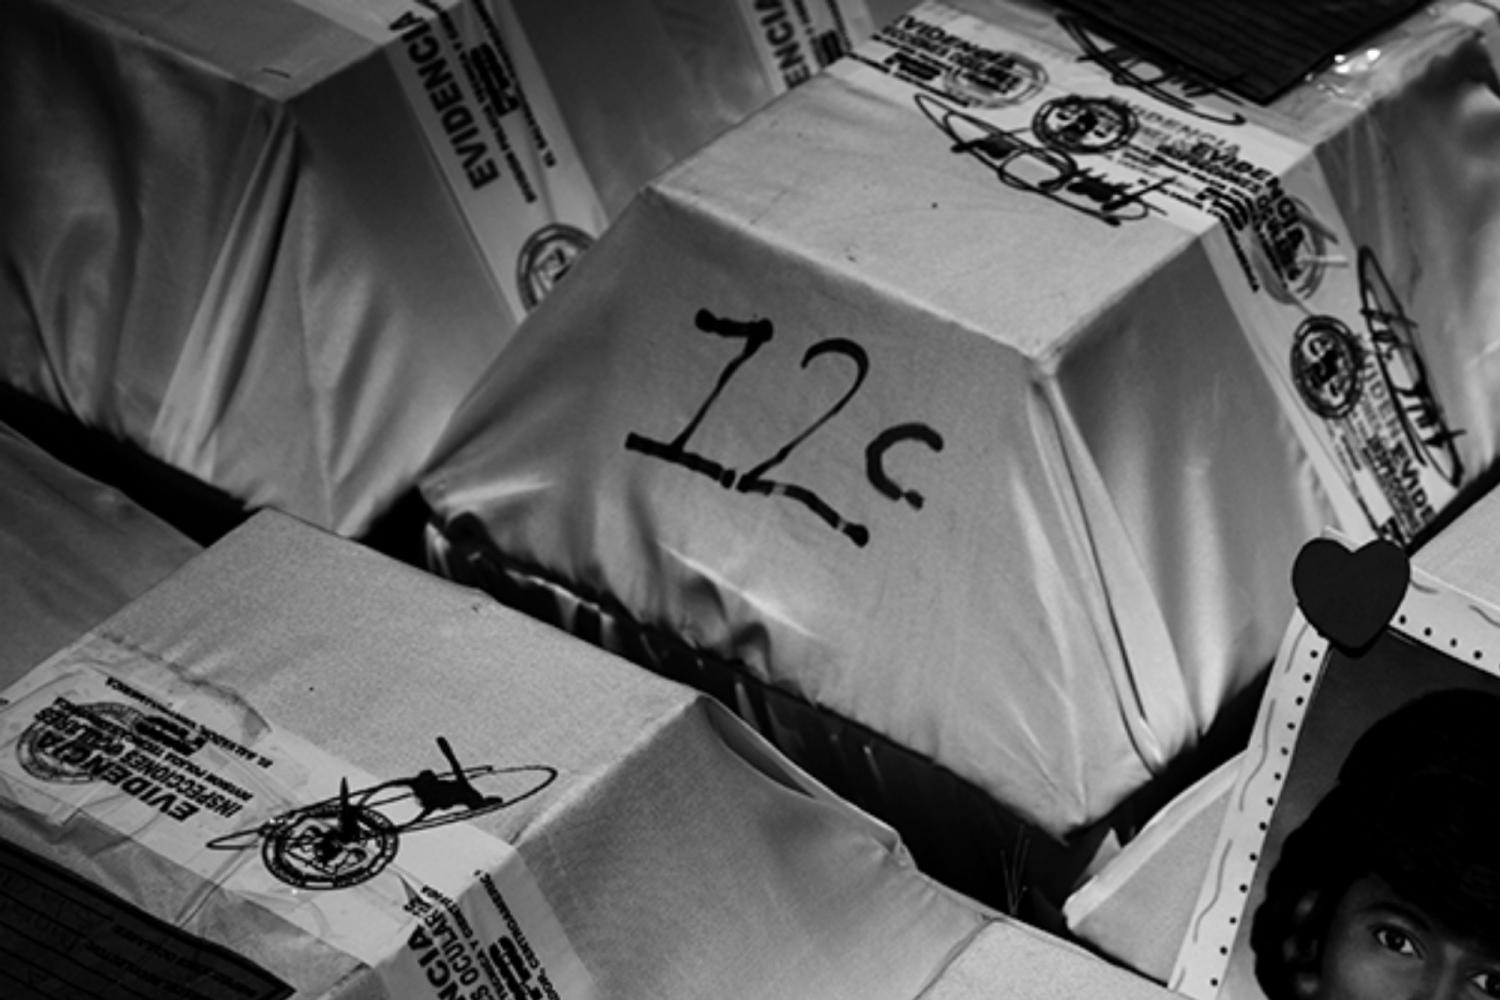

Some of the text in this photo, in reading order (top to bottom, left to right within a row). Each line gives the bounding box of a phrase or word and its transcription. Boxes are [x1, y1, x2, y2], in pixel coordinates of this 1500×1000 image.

[388, 10, 499, 190] EVIDENCIA
[34, 730, 200, 822] EVIDENCIA
[119, 749, 243, 818] INSPECCIONES
